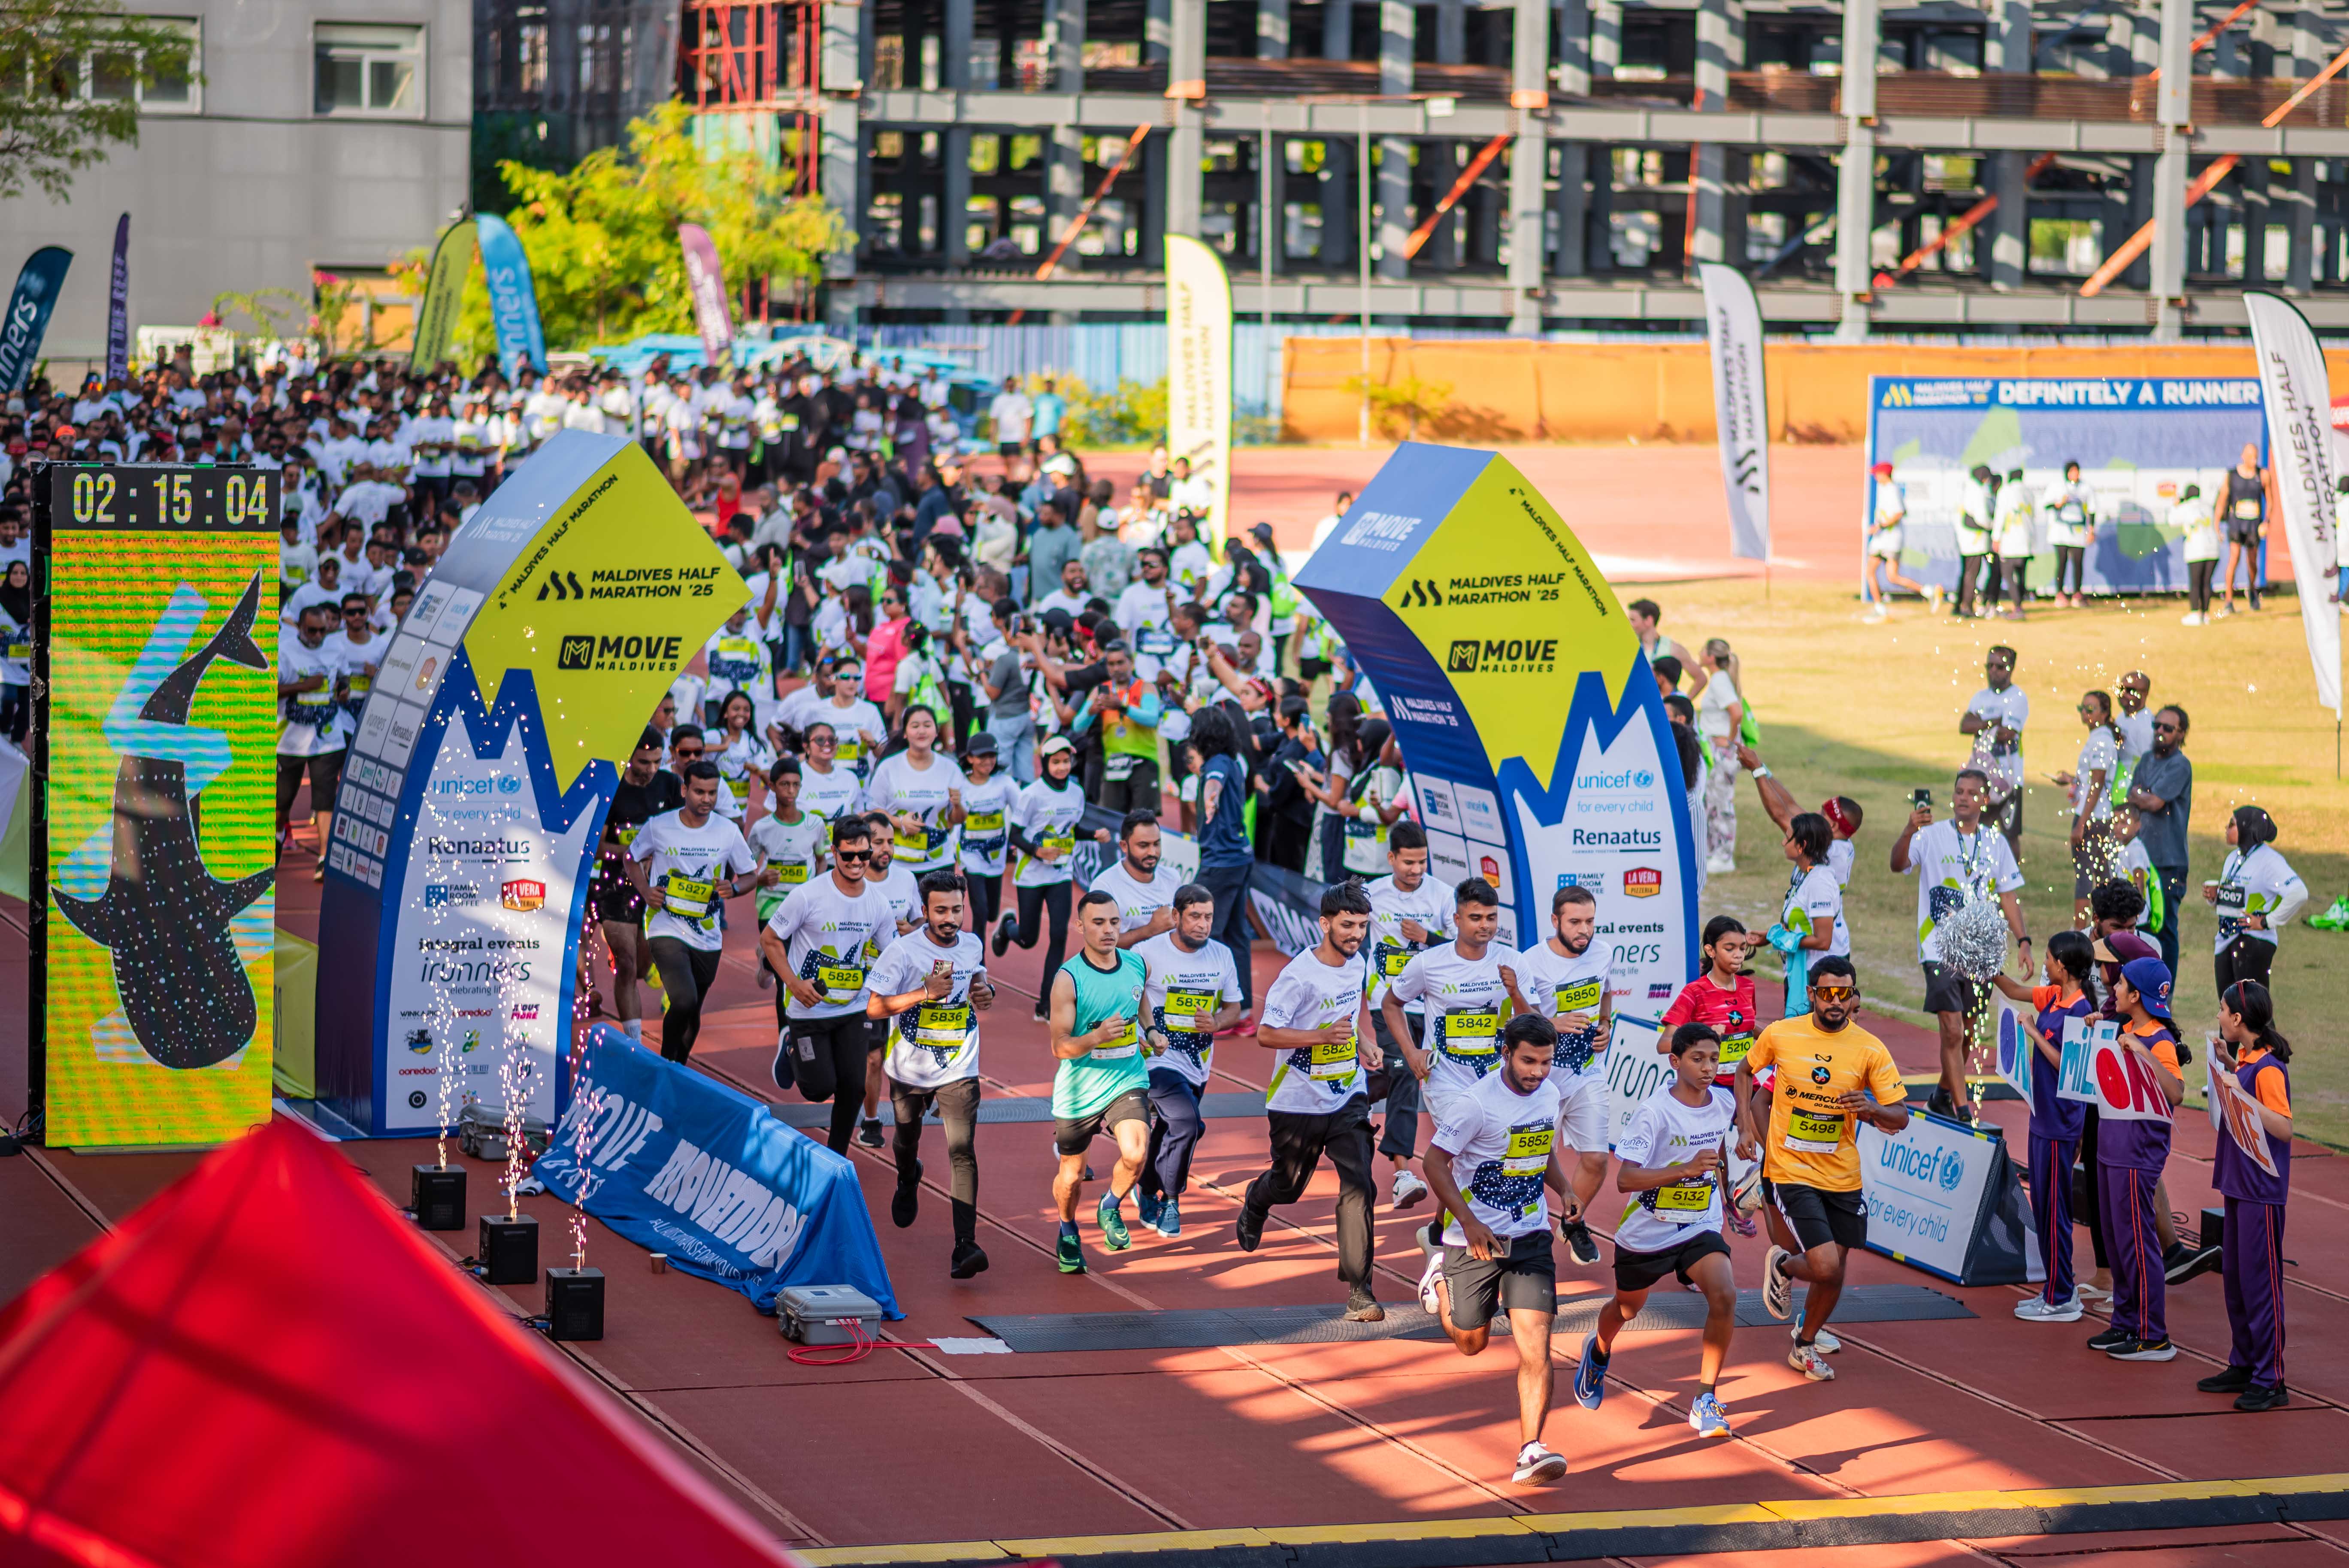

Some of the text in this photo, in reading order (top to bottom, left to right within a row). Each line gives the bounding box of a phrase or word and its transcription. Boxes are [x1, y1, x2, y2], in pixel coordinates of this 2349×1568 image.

[1998, 381, 2133, 405] DEFINITELY
[2137, 381, 2157, 405] A
[2162, 381, 2260, 405] RUNNER
[2271, 351, 2328, 542] MALDIVES HALF
[510, 546, 549, 594] MALDIVES
[547, 521, 569, 547] HALF
[569, 474, 618, 523] MARATHON
[1366, 514, 1422, 541] MOVE
[1521, 500, 1557, 542] MALDIVES
[1555, 541, 1575, 563] HALF
[1572, 565, 1608, 617] MARATHON
[592, 567, 720, 582] MALDIVES HALF
[1450, 573, 1565, 590] MALDIVES HALF
[590, 584, 714, 599] MARATHON '25
[1448, 589, 1559, 605] MARATHON '25
[598, 636, 682, 659] MOVE
[1483, 639, 1559, 662] MOVE
[595, 661, 677, 671] MALDIVES
[1480, 663, 1554, 672] MALDIVES
[1405, 697, 1452, 712] MALDIVES HALF
[1410, 711, 1447, 725] MARATHON
[390, 720, 414, 742] Renaatus
[433, 775, 494, 794] unicef
[1577, 770, 1632, 789] unicef
[1577, 800, 1653, 814] for every child
[453, 809, 490, 822] every
[1573, 828, 1661, 845] Renaatus
[428, 837, 530, 855] Renaatus
[1432, 853, 1466, 869] integral events
[1628, 871, 1656, 883] LA VERA
[520, 883, 540, 896] VERA
[678, 882, 707, 895] 5827
[1618, 922, 1664, 933] events
[419, 937, 540, 953] integral events
[421, 957, 532, 982] irunners
[828, 971, 859, 982] 5825
[1628, 966, 1639, 975] life
[1176, 996, 1208, 1008] 5837
[1336, 990, 1356, 1000] MALDIVES
[1566, 987, 1596, 1003] 5850
[1647, 991, 1671, 999] MORE
[929, 1011, 963, 1022] 5836
[1456, 1017, 1492, 1028] 5842
[1322, 1041, 1352, 1056] 5820
[1727, 1041, 1751, 1053] 5210
[556, 1072, 663, 1172] MOVE
[1799, 1121, 1836, 1134] 5498
[1518, 1134, 1550, 1148] 5852
[1689, 1138, 1717, 1147] MARATHON
[1690, 1132, 1715, 1140] MALDIVES
[1880, 1137, 1943, 1184] unicef
[1672, 1190, 1705, 1201] 5132
[1868, 1191, 1949, 1243] for every child
